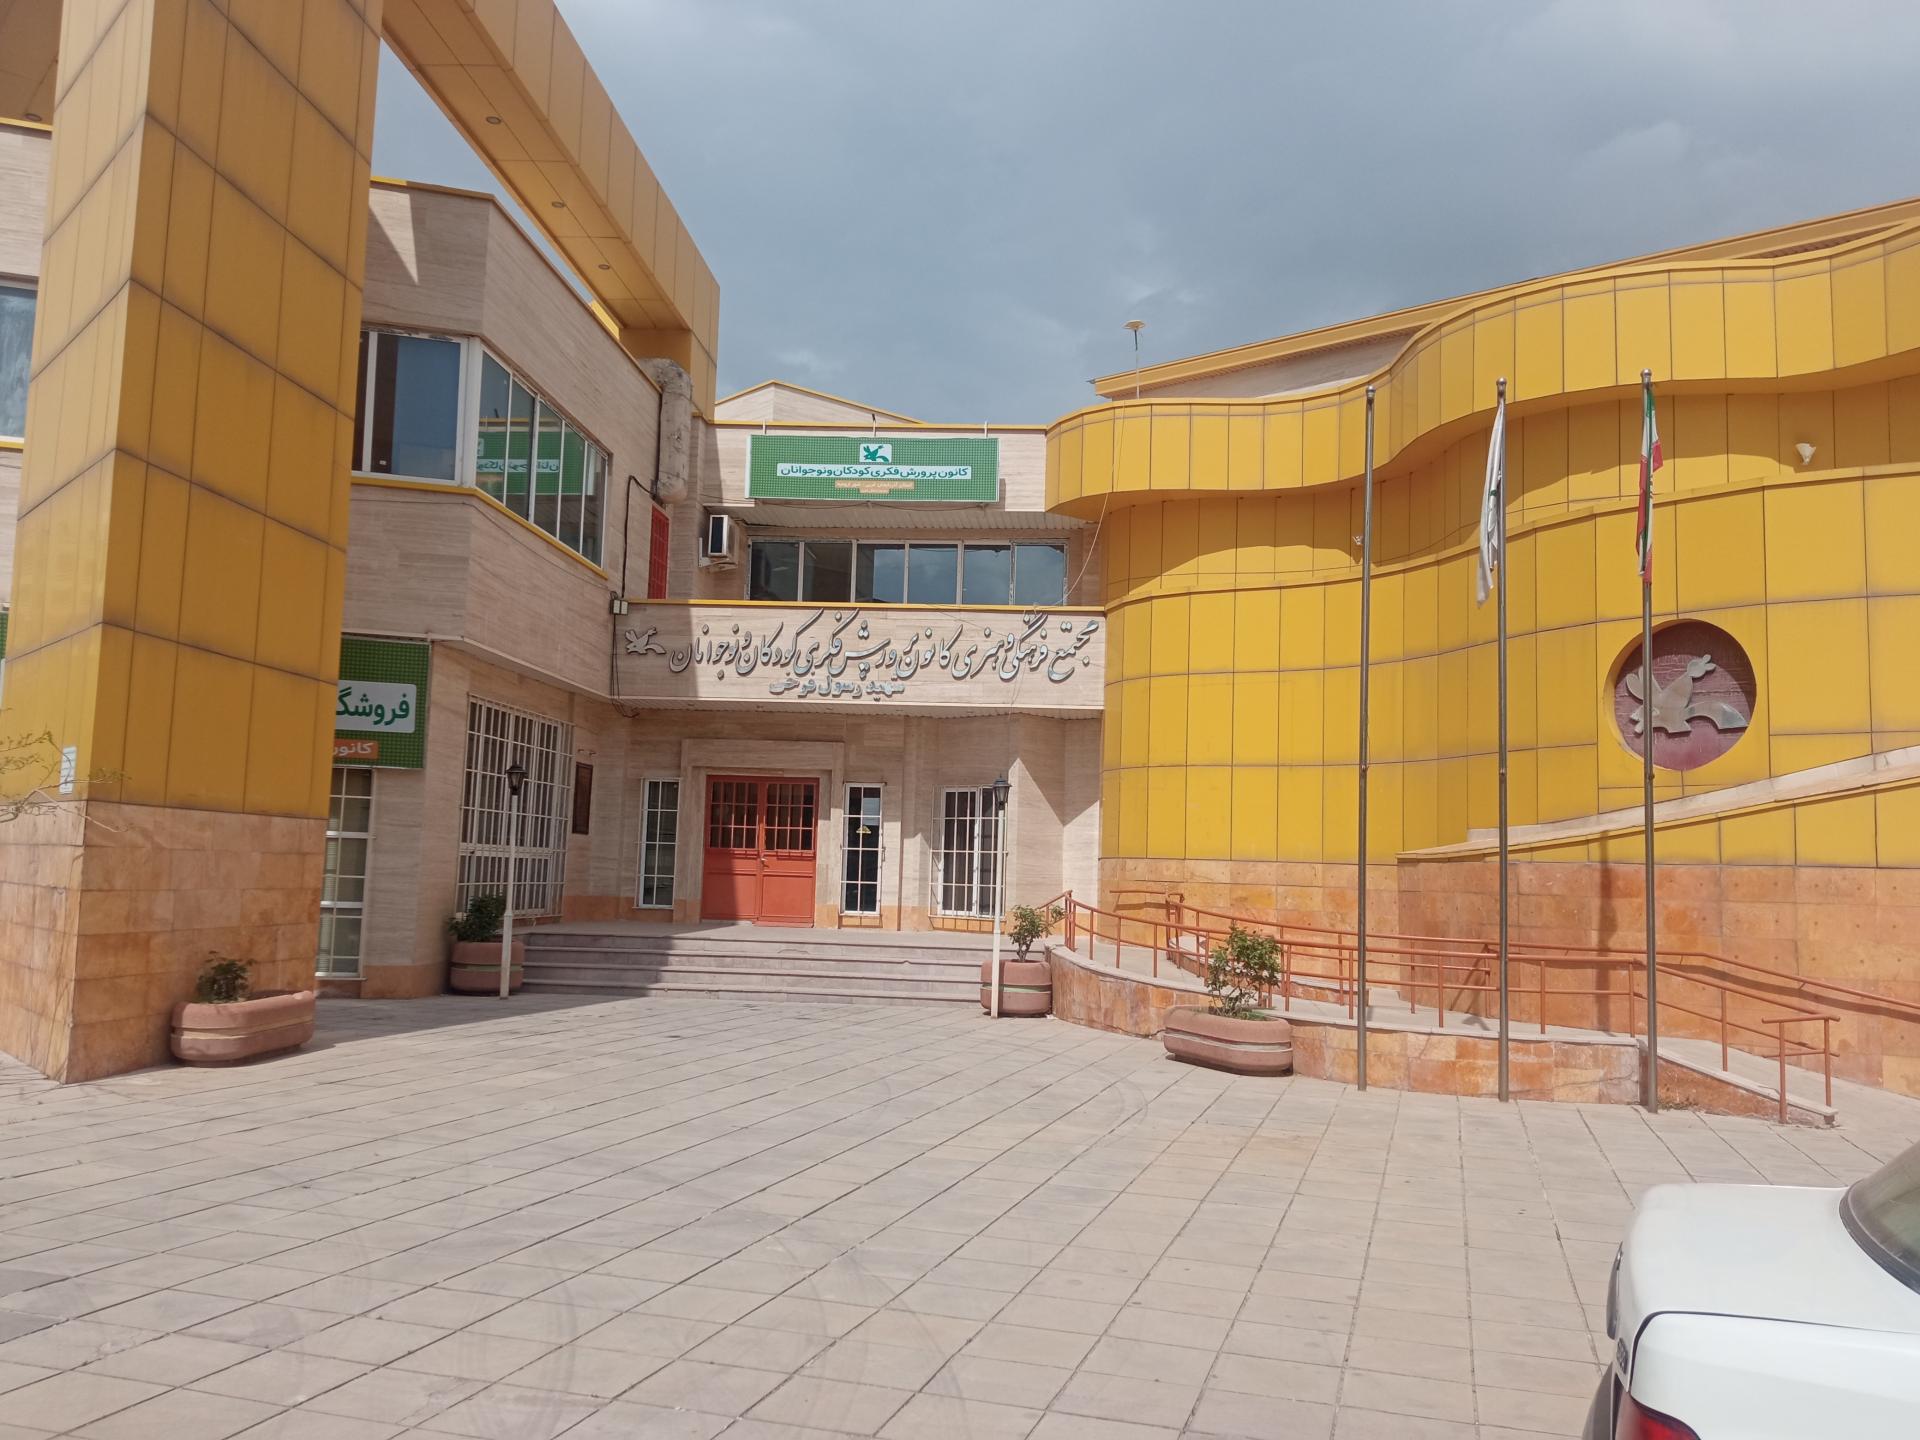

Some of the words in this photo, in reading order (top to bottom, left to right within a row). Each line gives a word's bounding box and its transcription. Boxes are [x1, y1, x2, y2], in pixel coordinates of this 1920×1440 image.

[833, 466, 871, 477] کودکان
[871, 467, 899, 478] فکری
[900, 468, 937, 480] پرورش
[938, 467, 968, 479] کانون
[669, 623, 740, 680] نوجوانان
[736, 607, 824, 677] کودکان
[793, 607, 860, 677] فکری
[827, 620, 919, 679] پرورش
[896, 624, 963, 678] کانون
[951, 627, 1006, 679] هنری
[999, 612, 1049, 682] فرهنگی
[1048, 620, 1099, 682] مجتمع
[336, 687, 410, 726] فروشگ
[818, 675, 862, 698] رسول
[865, 677, 906, 702] شهید
